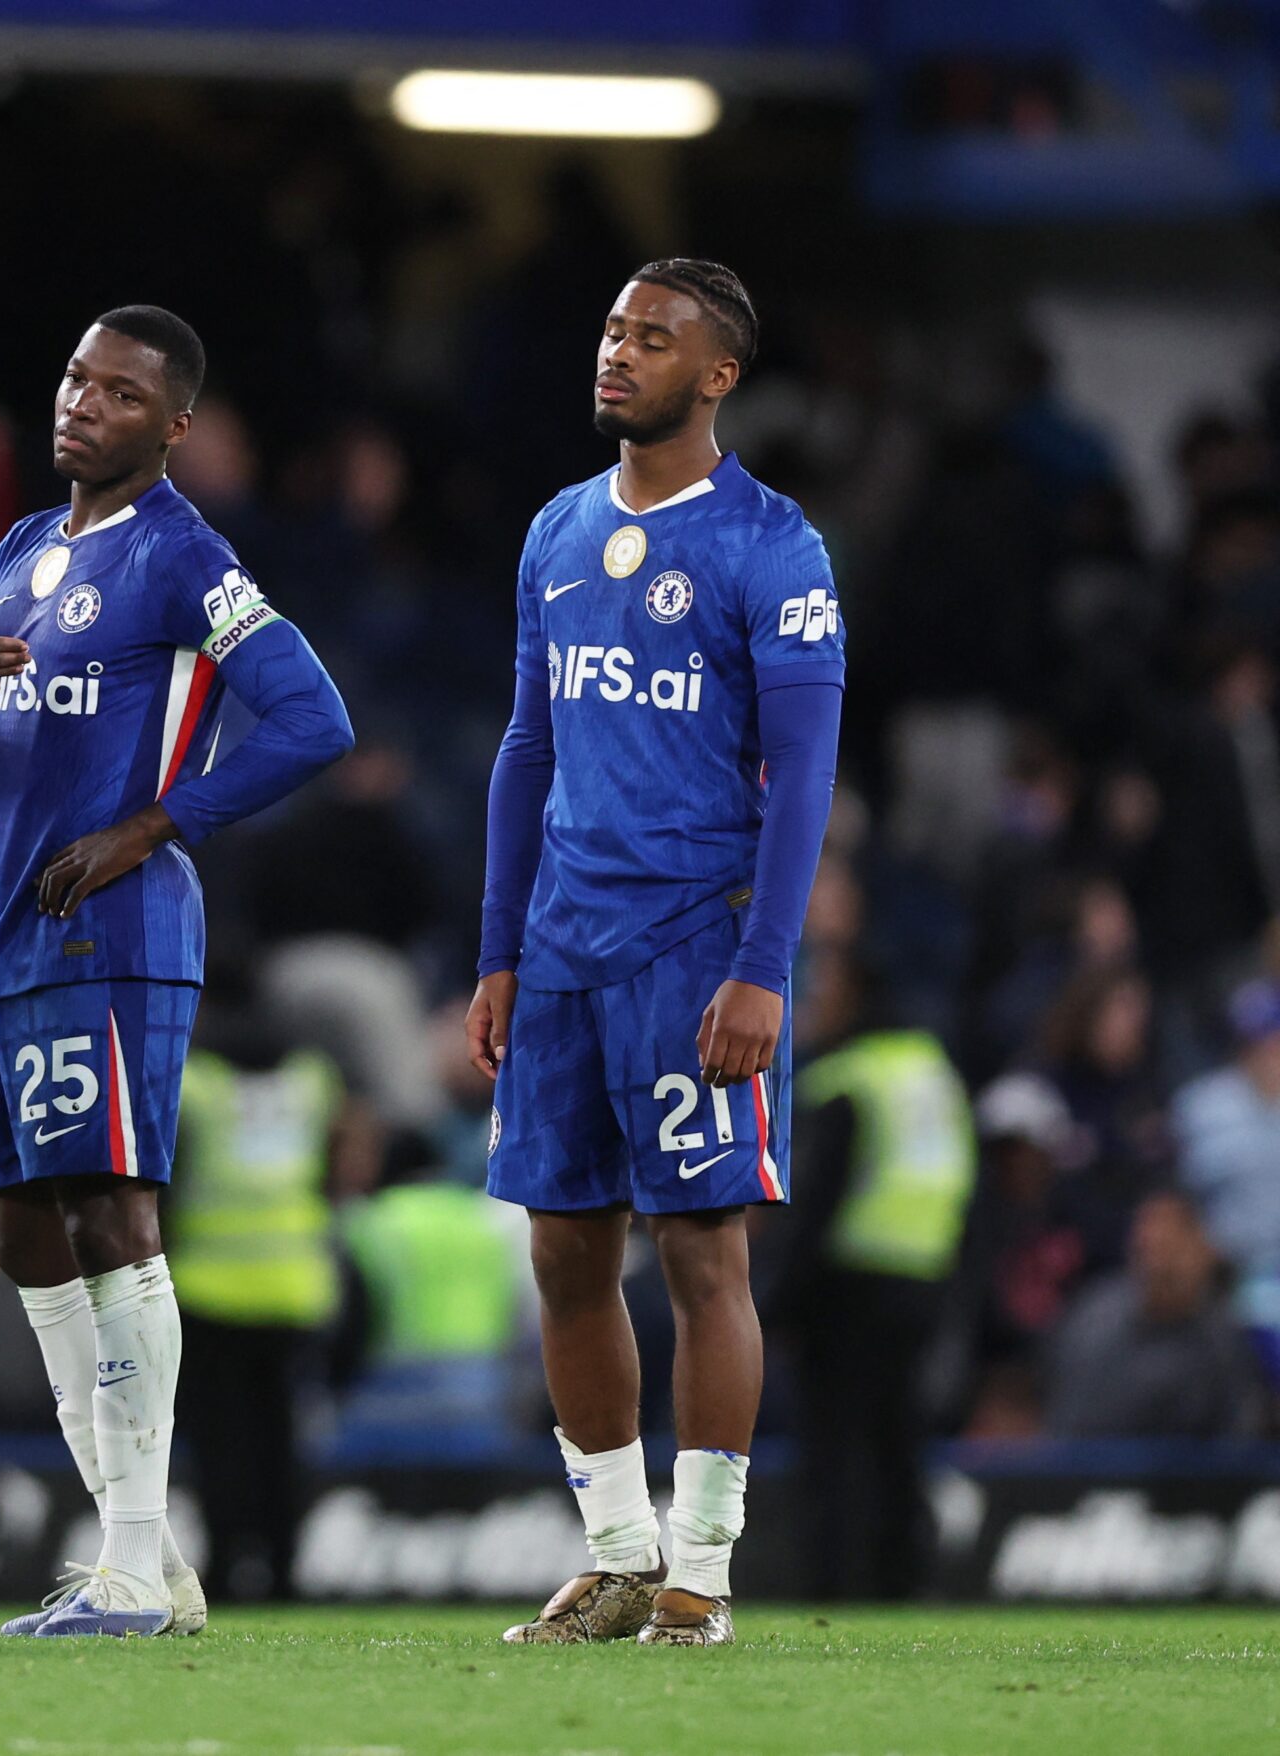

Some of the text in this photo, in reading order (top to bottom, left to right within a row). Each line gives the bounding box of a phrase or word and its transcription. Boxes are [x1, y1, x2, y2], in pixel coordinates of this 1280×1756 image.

[72, 586, 98, 600] CHELSEA
[660, 573, 688, 587] CHELSEA
[211, 607, 272, 656] captain
[563, 645, 704, 713] IFS.ai
[15, 1034, 99, 1124] 25
[653, 1072, 734, 1153] 21
[98, 1359, 137, 1374] CFC
